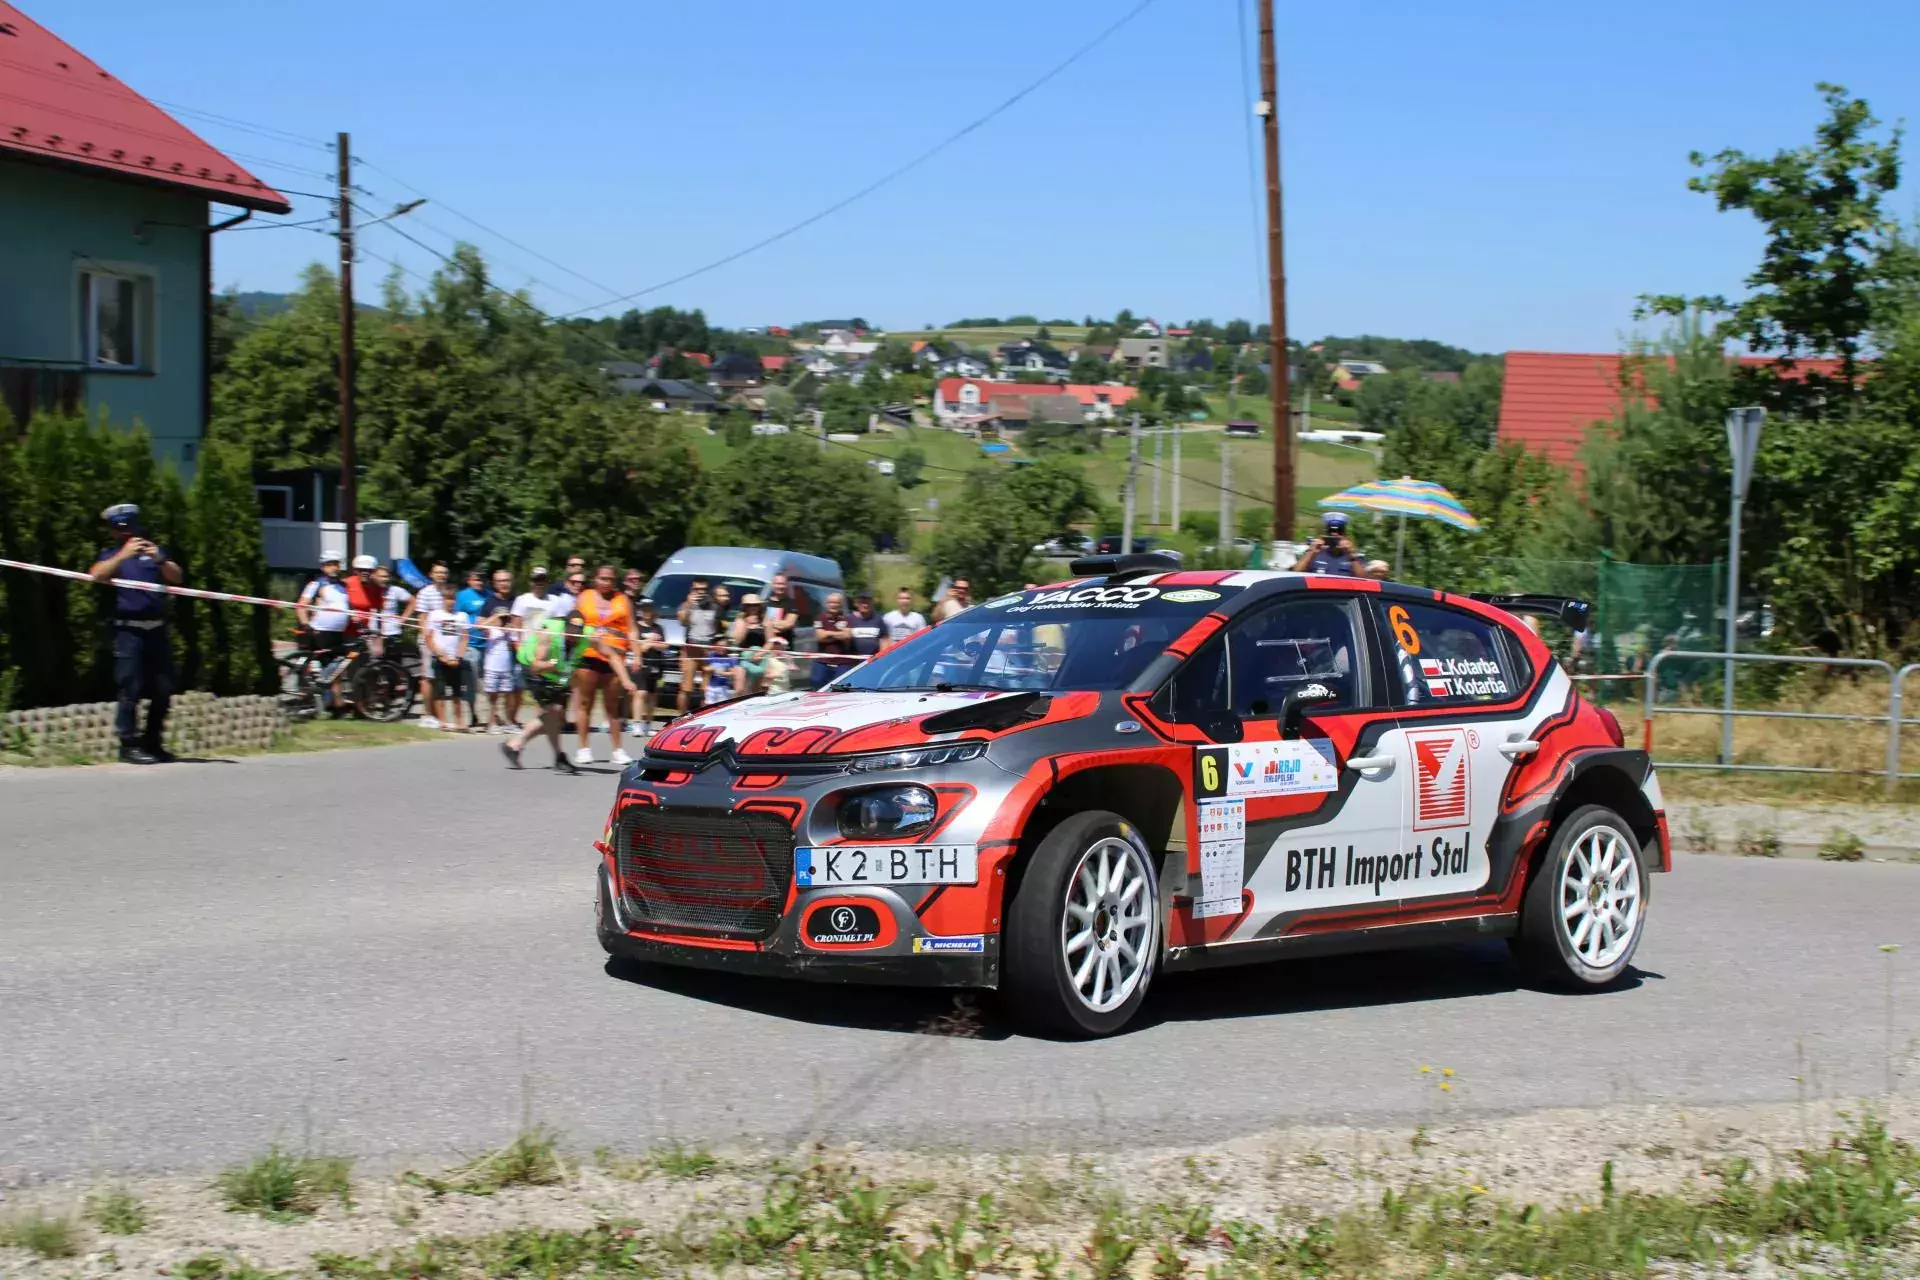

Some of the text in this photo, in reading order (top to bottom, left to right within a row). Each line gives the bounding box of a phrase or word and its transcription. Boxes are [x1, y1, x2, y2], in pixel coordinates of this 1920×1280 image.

[1027, 587, 1160, 605] YACCO
[1389, 605, 1421, 655] 6
[1445, 678, 1507, 696] T.Kotarba
[1201, 755, 1219, 791] 6
[826, 848, 958, 882] K2 BTH
[1285, 846, 1337, 892] BTH
[1345, 844, 1423, 896] Import
[1430, 831, 1470, 877] Stal
